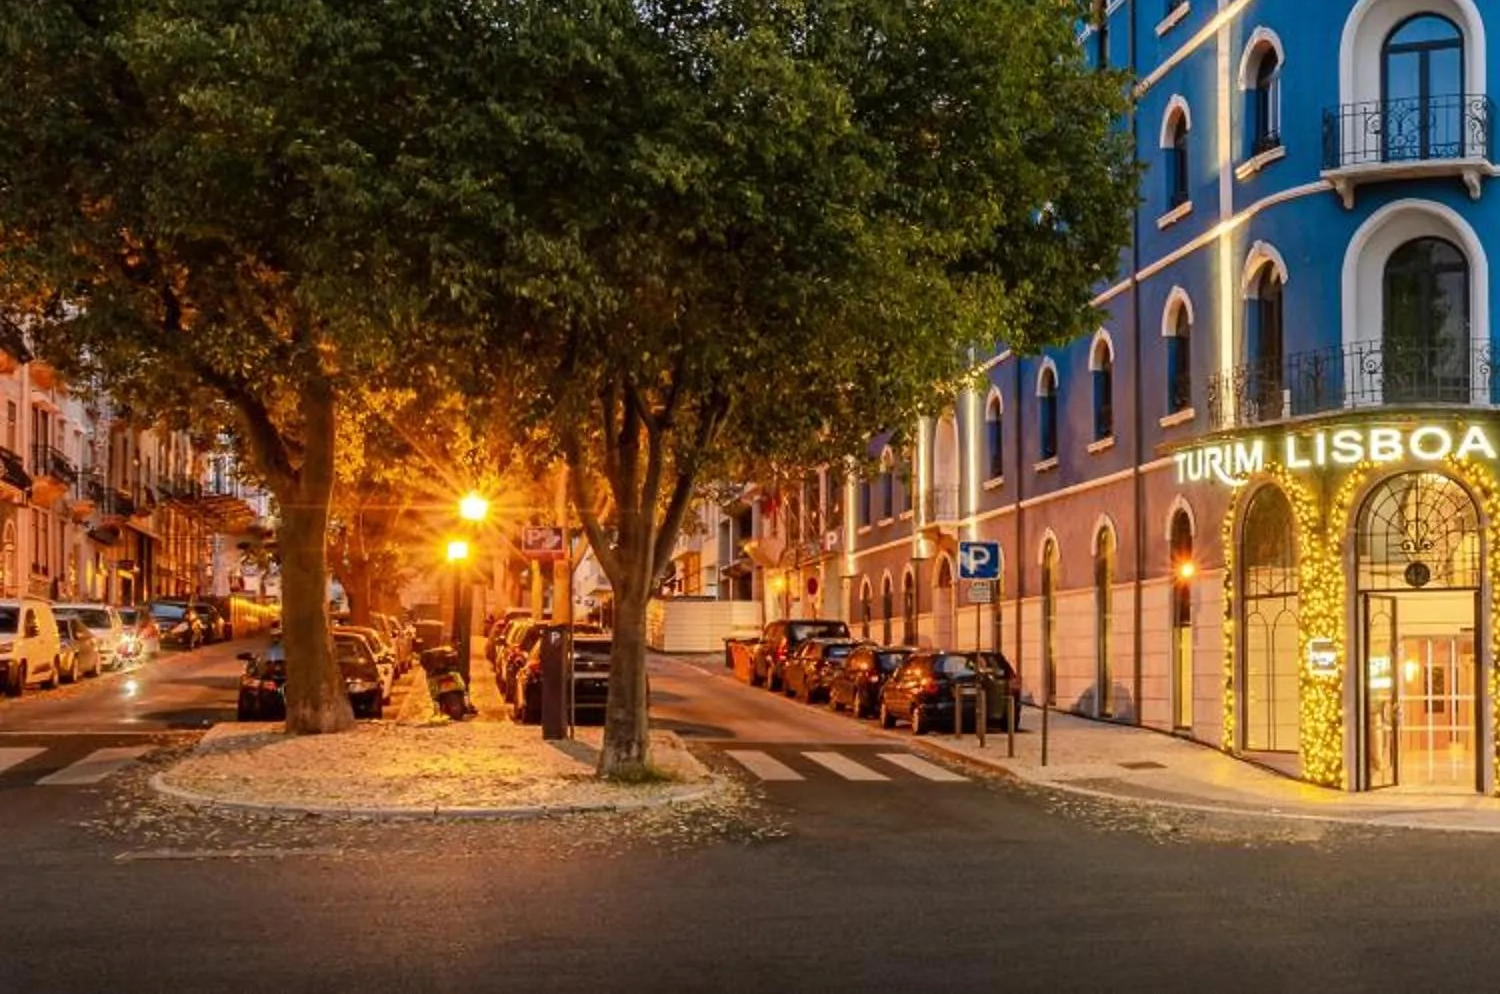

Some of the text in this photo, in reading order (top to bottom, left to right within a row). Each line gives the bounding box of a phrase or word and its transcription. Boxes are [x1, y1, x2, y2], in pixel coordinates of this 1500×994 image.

[1174, 439, 1264, 486] TURIM
[1286, 425, 1498, 468] LISBOA
[969, 546, 990, 574] P
